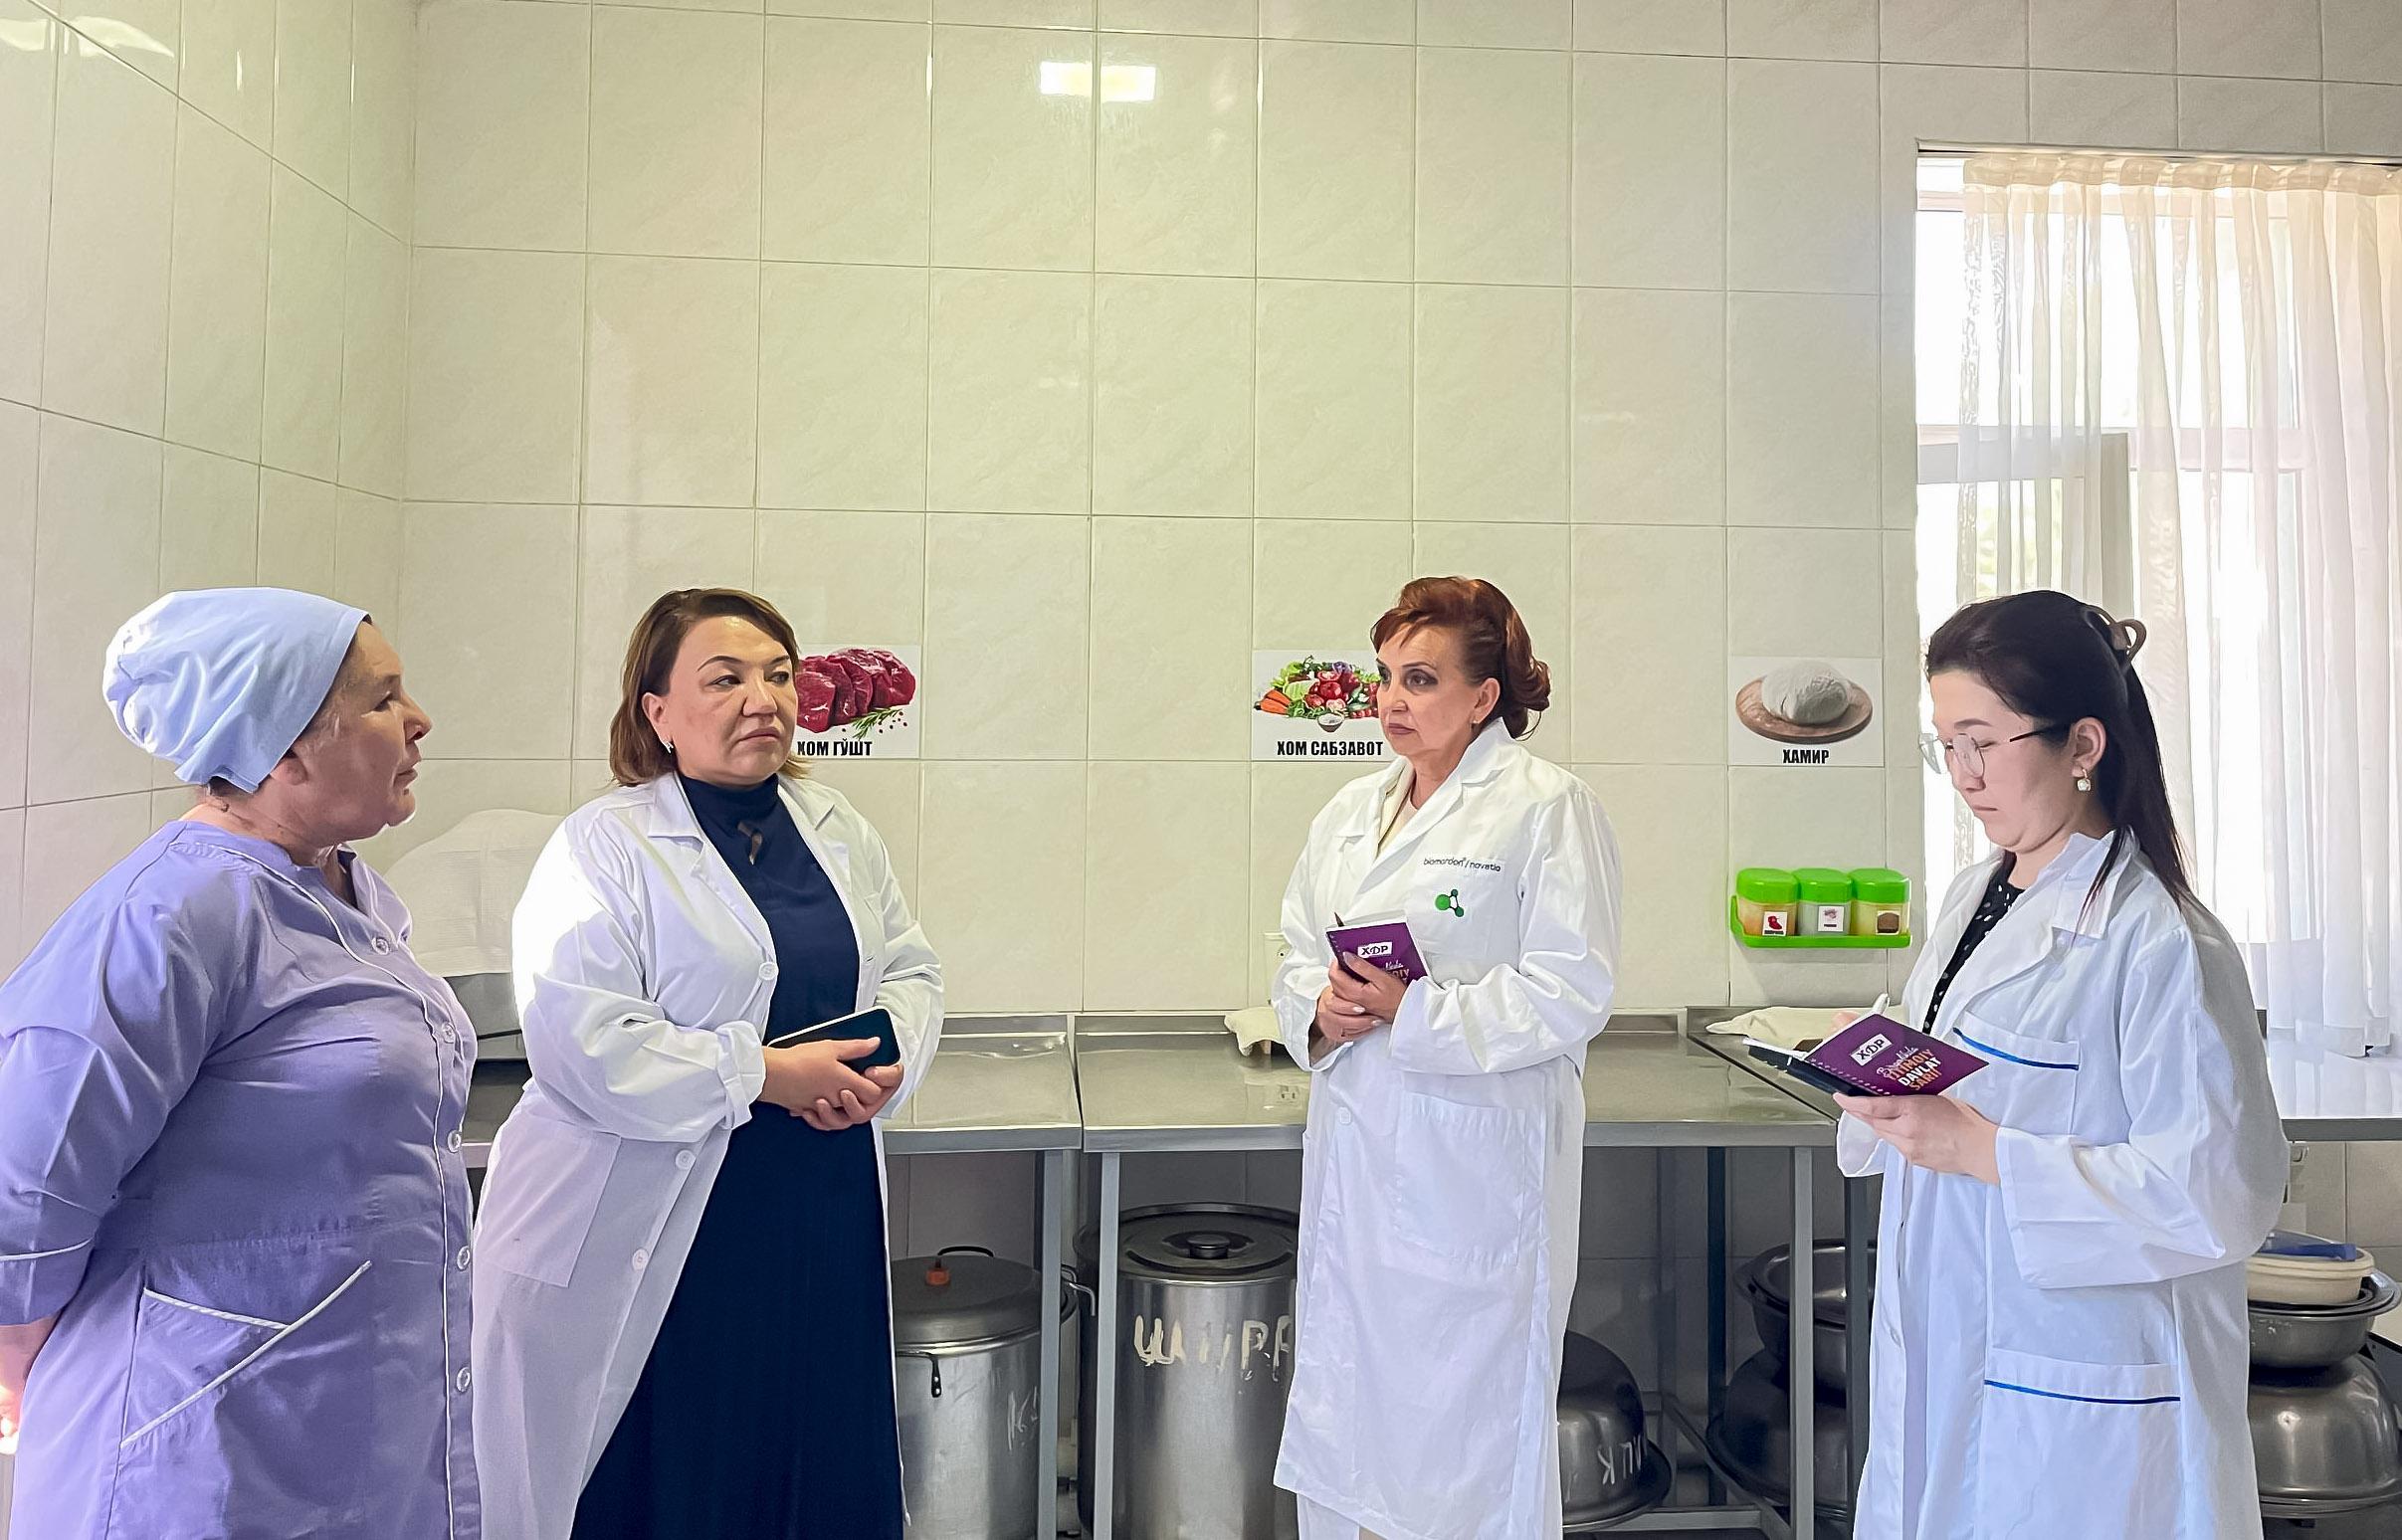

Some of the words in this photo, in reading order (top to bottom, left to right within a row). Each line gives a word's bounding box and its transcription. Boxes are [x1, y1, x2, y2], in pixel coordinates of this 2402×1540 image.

[797, 740, 829, 756] ХОМ
[833, 738, 873, 756] ГЎШТ
[1277, 741, 1307, 756] ХОМ
[1310, 741, 1384, 756] САБЗАВОТ
[1782, 749, 1830, 764] ХАМИР
[1361, 945, 1389, 956] XDP
[1857, 1039, 1885, 1060] XDP
[1898, 1057, 1942, 1087] DAVLAT
